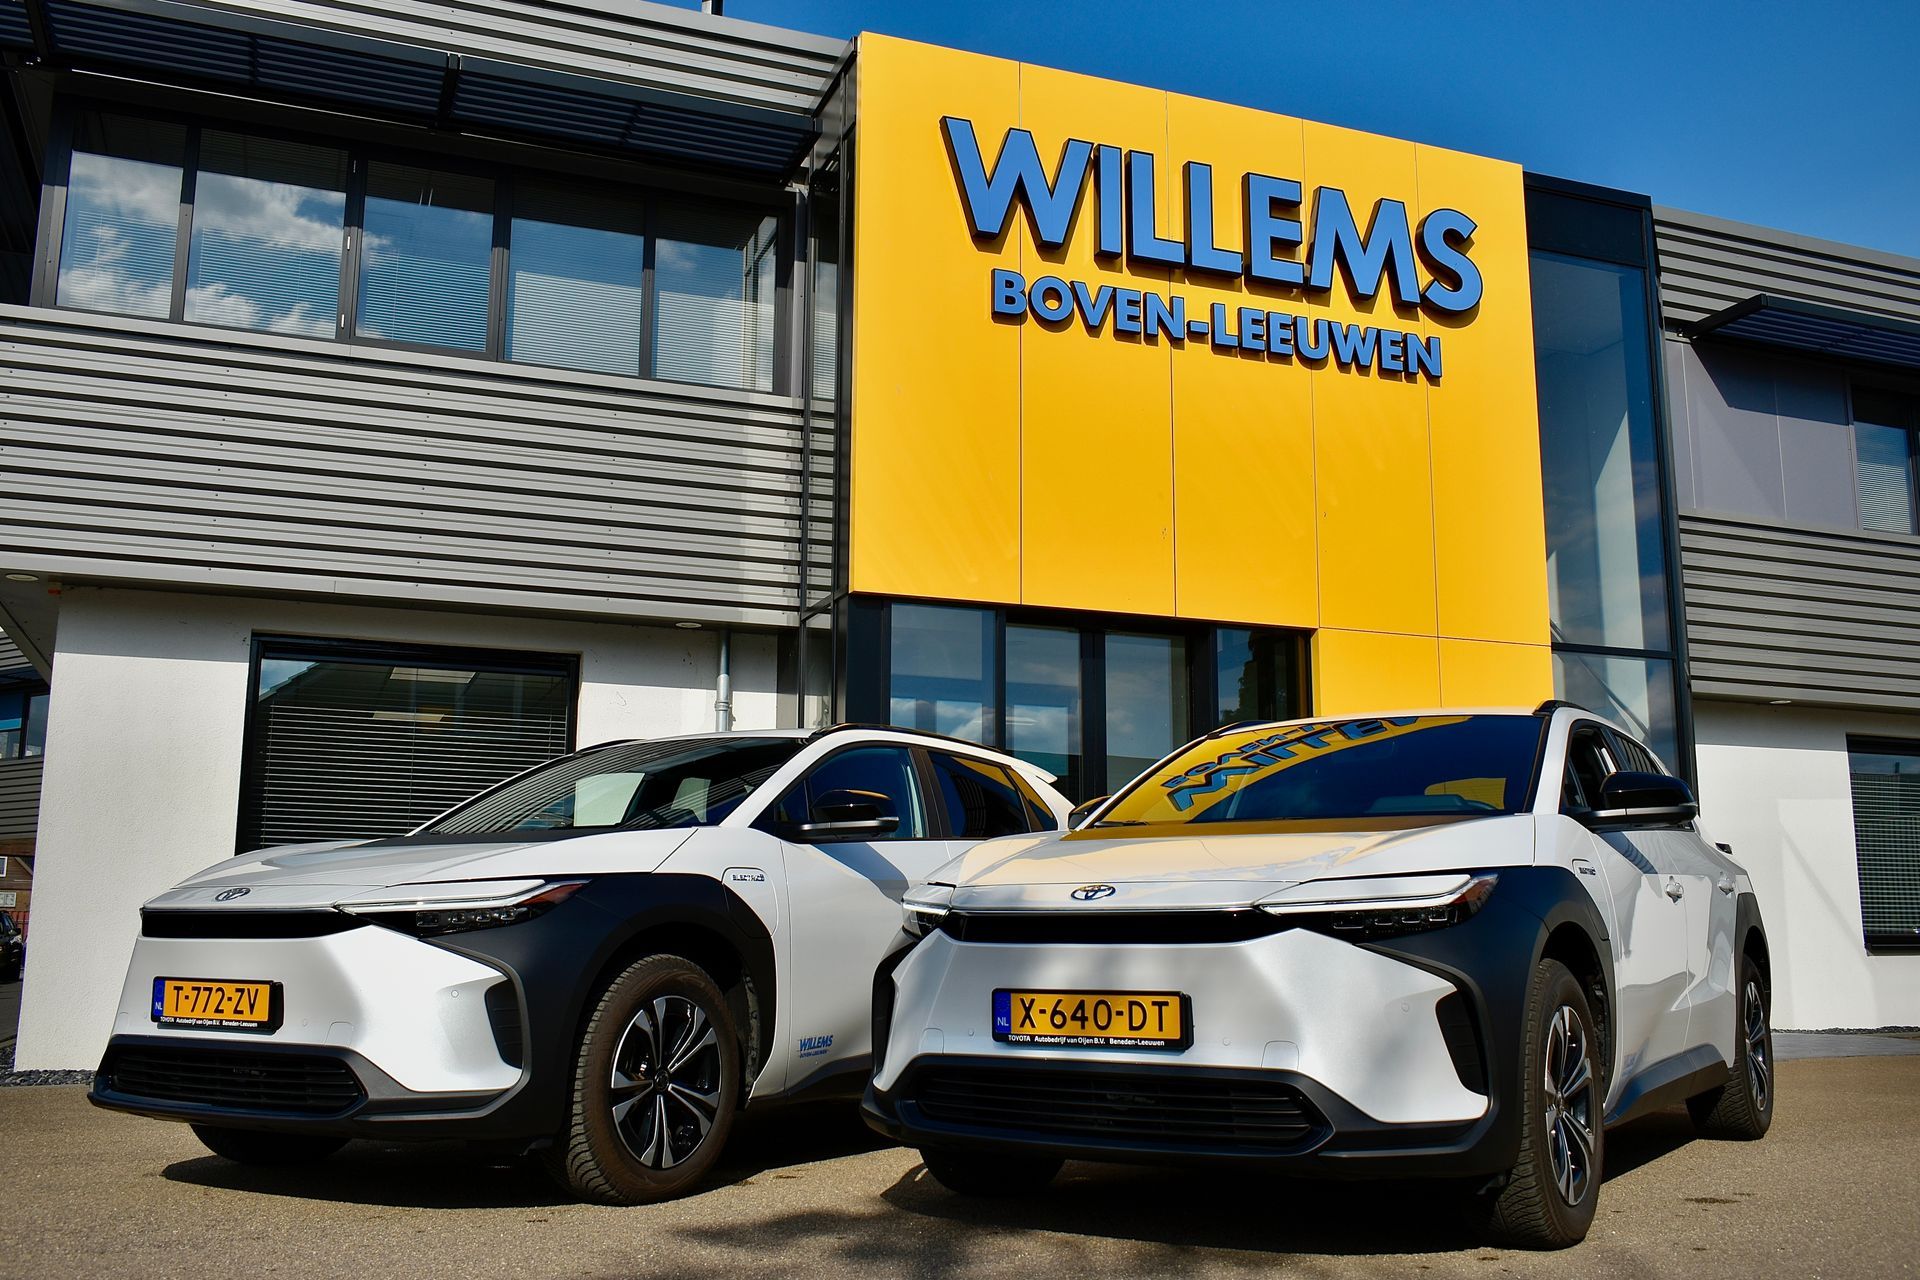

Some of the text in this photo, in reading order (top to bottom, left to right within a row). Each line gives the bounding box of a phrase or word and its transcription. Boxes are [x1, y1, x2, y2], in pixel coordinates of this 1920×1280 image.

[940, 115, 1483, 313] WILLEMS
[991, 268, 1442, 379] BOVEN-LEEUWEN
[154, 1001, 163, 1010] NL
[173, 985, 259, 1015] T-772-ZV
[997, 1016, 1009, 1027] NL
[1019, 997, 1169, 1032] X-640-DT
[800, 1035, 834, 1051] WILLEMS
[1008, 1034, 1031, 1042] TOYOTA
[1034, 1035, 1066, 1045] Autobedrijf
[1078, 1037, 1094, 1045] Oijen
[1109, 1037, 1165, 1047] Beneden-Leeuwen
